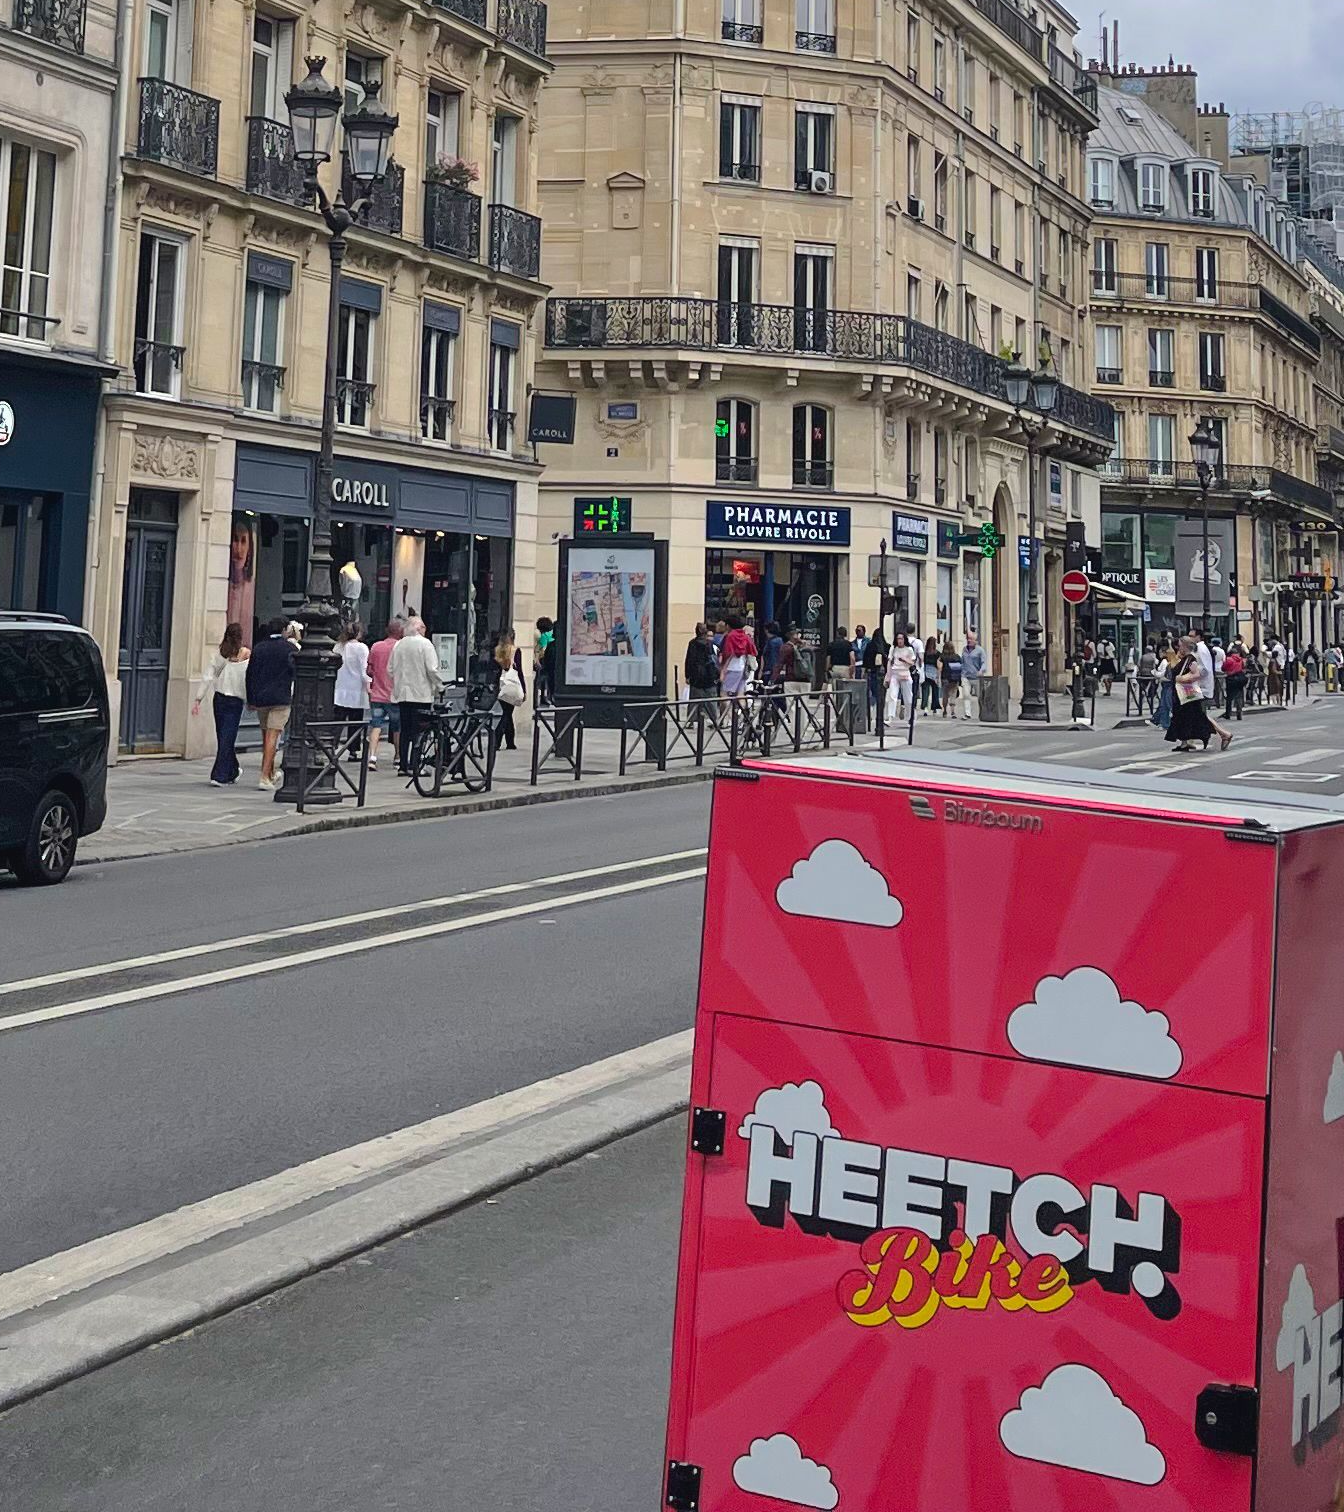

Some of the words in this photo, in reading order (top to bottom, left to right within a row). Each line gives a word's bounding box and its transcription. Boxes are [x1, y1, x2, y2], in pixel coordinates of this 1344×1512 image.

[532, 428, 567, 439] CAROLL
[331, 477, 390, 507] CAROLL
[724, 506, 839, 527] PHARMACIE
[728, 524, 781, 538] LOUVRE
[785, 527, 831, 541] RIVOLI
[836, 1226, 1075, 1330] Bike
